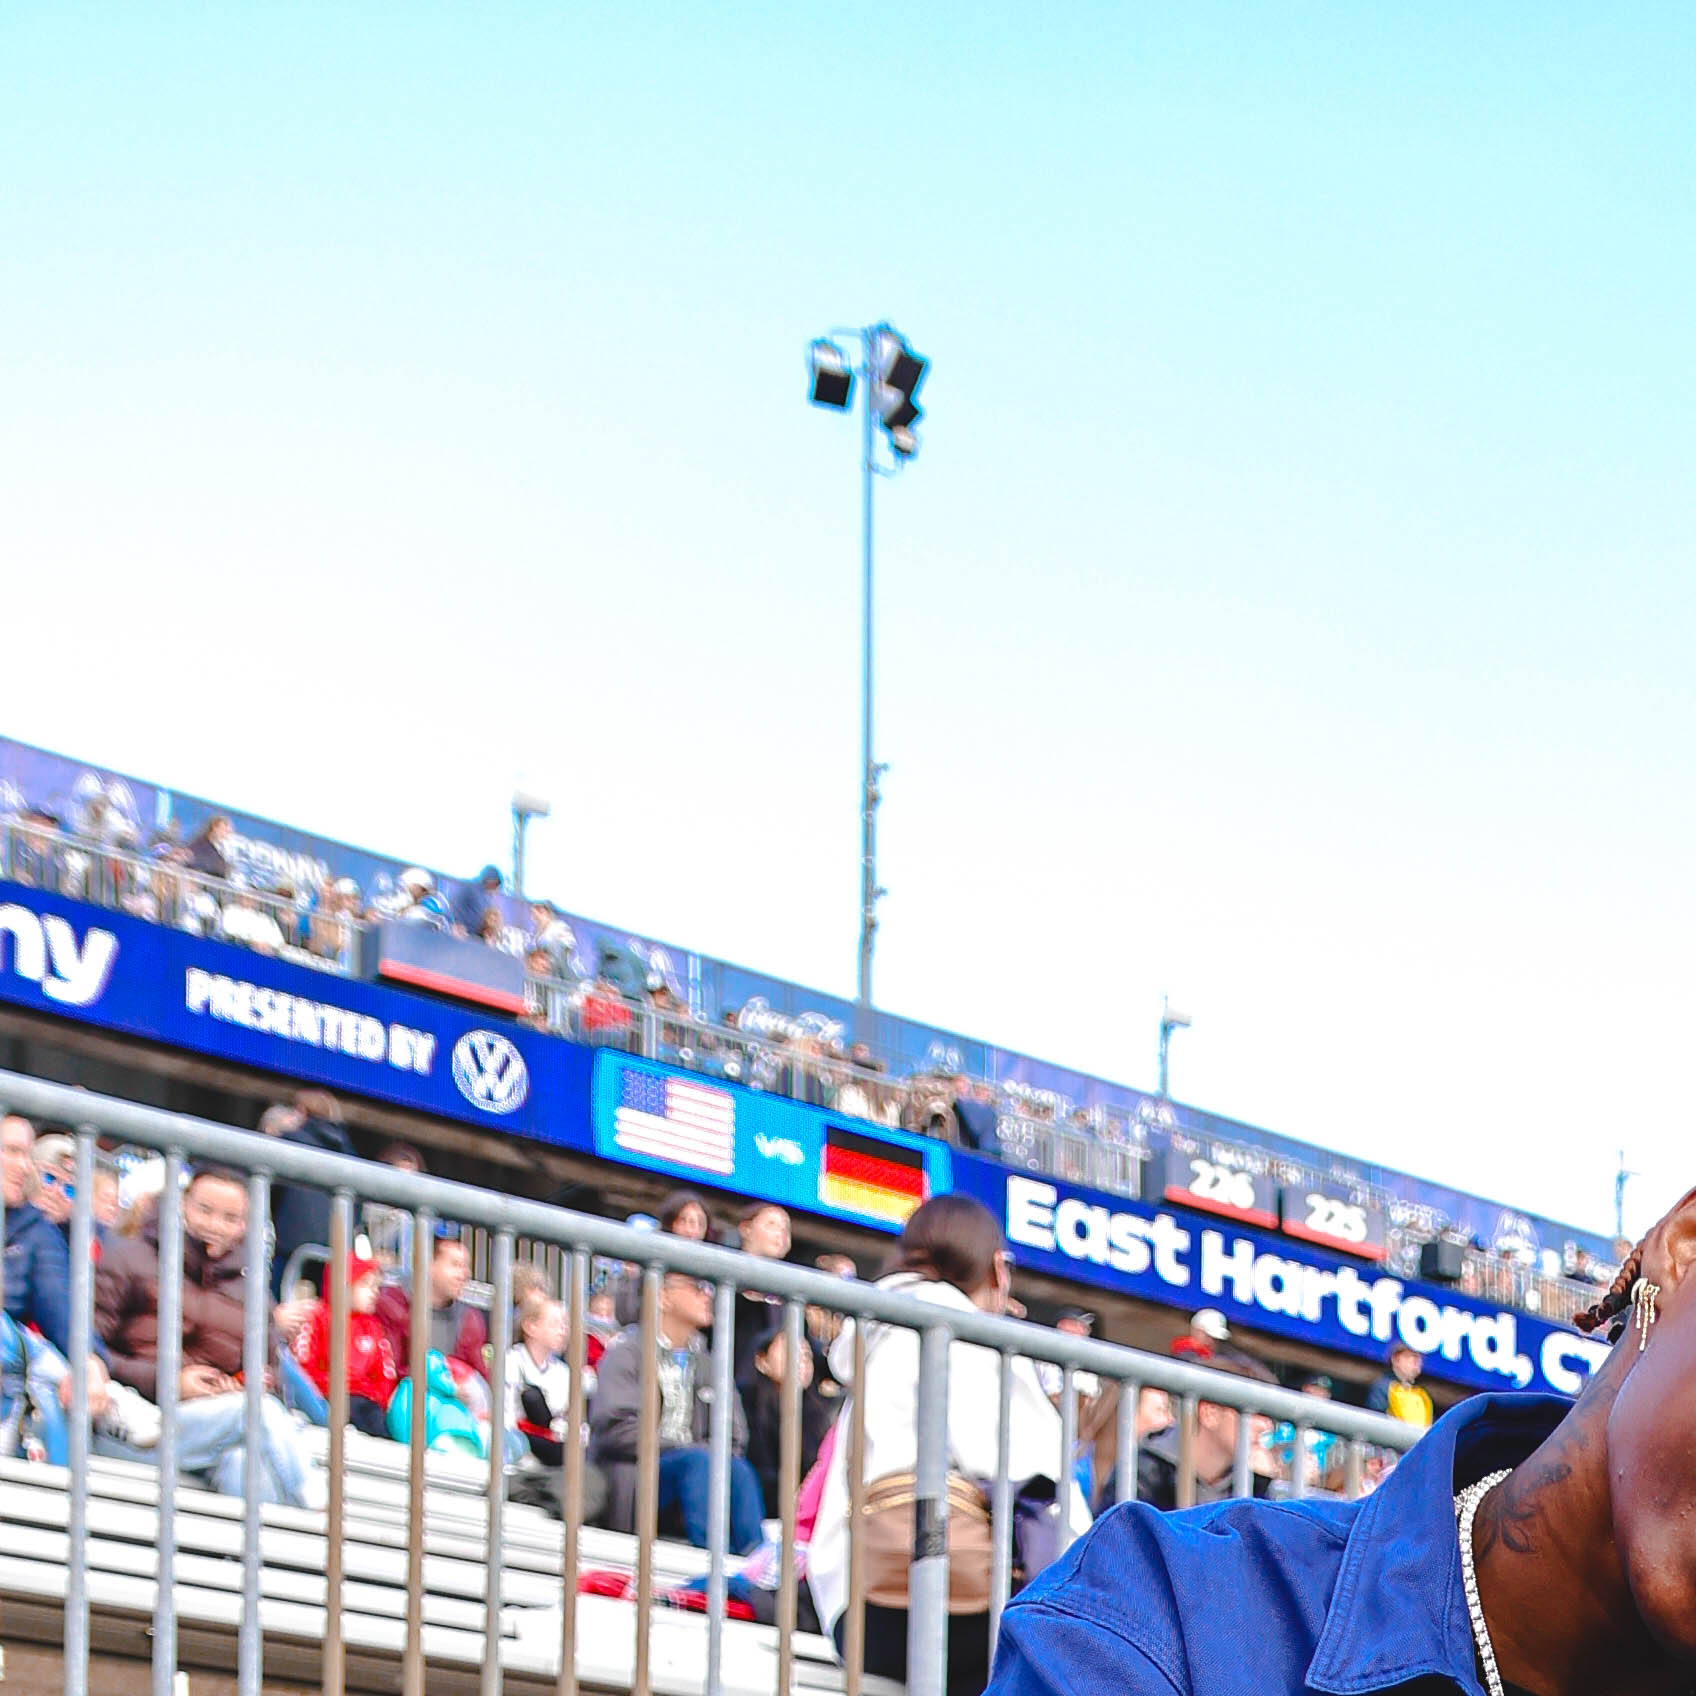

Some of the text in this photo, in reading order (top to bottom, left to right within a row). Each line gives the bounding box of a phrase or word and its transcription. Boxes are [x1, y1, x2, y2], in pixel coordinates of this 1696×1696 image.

[186, 967, 437, 1077] PRESENTED BY
[1189, 1158, 1256, 1209] 226
[1304, 1192, 1368, 1243] 225
[1006, 1174, 1191, 1288] East
[1200, 1228, 1533, 1389] Hartford,
